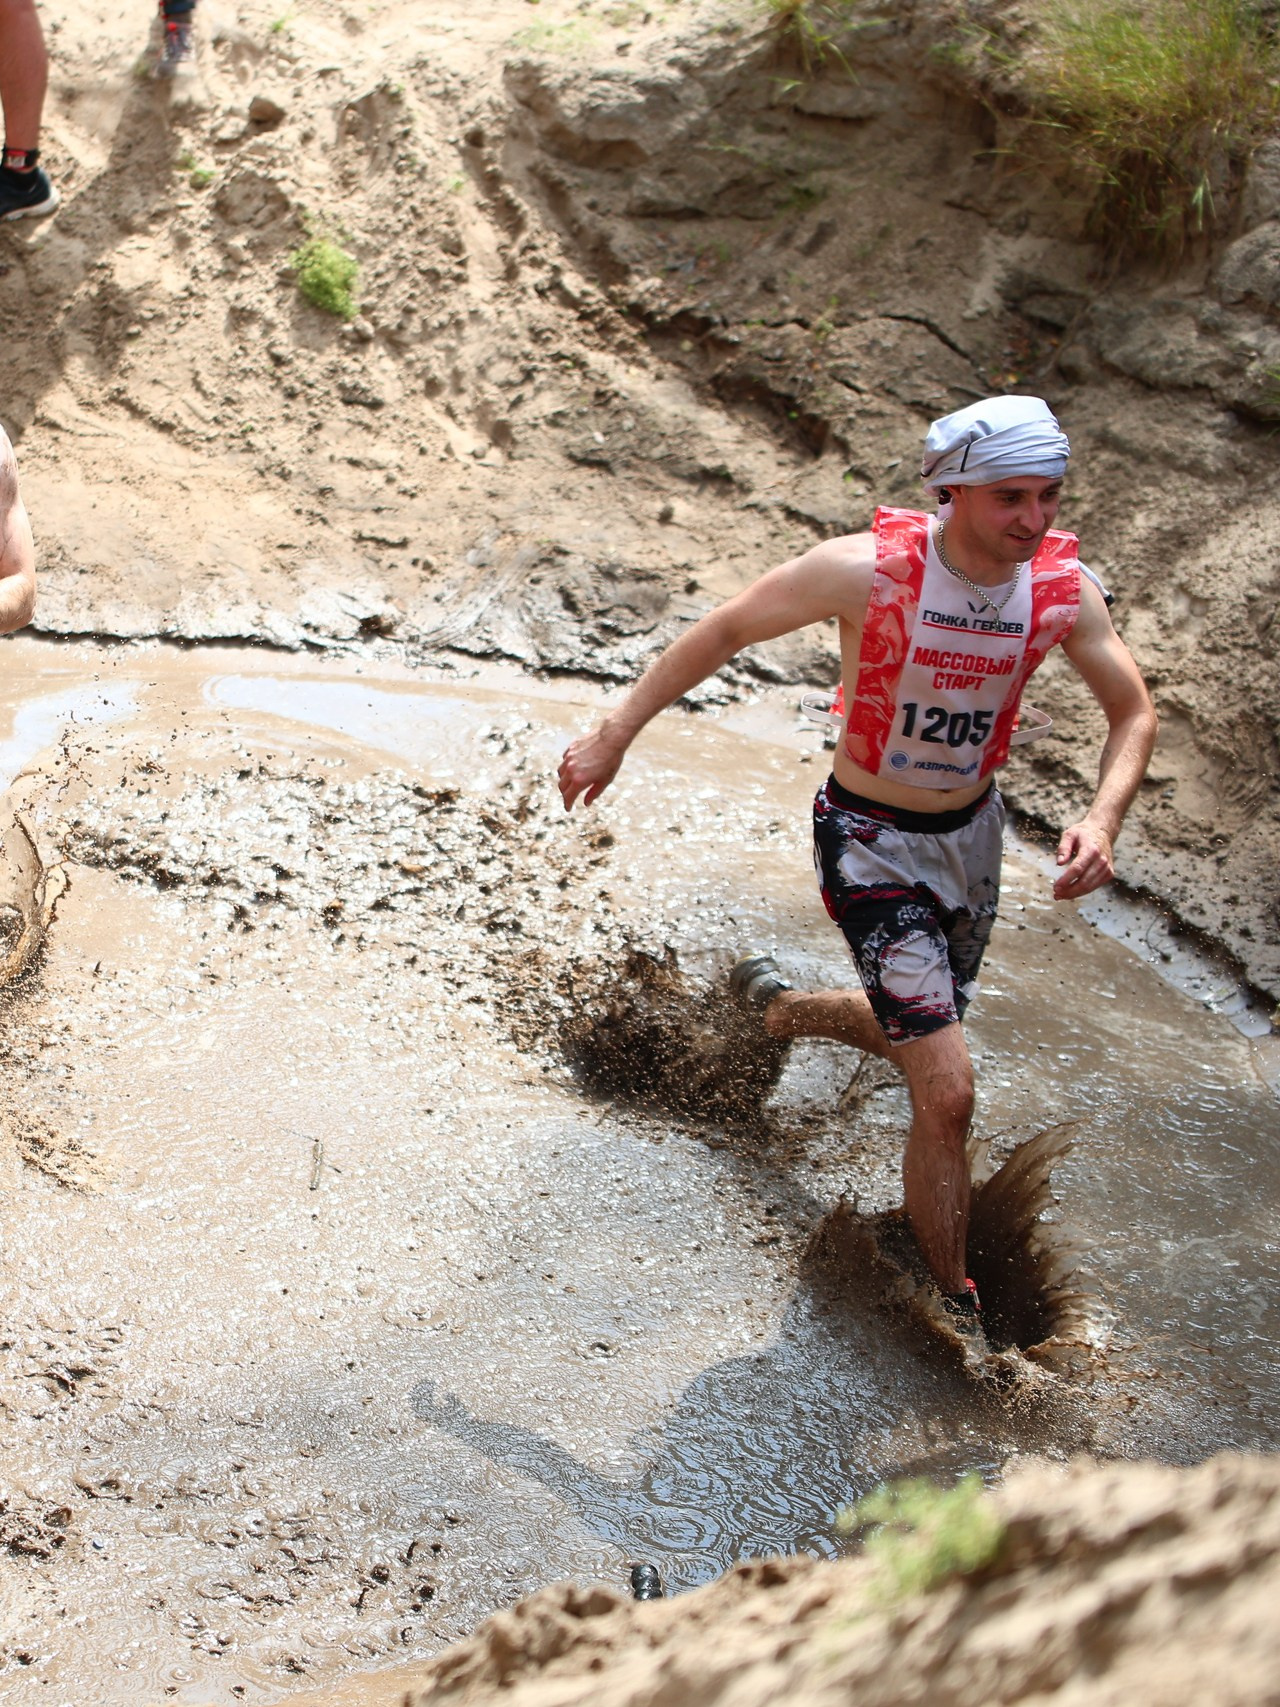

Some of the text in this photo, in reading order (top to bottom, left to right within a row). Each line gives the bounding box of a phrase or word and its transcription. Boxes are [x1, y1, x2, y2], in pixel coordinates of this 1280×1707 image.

[923, 610, 1024, 634] ГОНКА ГЕРОЕВ
[912, 647, 1016, 676] МАССОВЫЙ
[933, 672, 986, 690] СТАРТ
[902, 703, 994, 748] 1205
